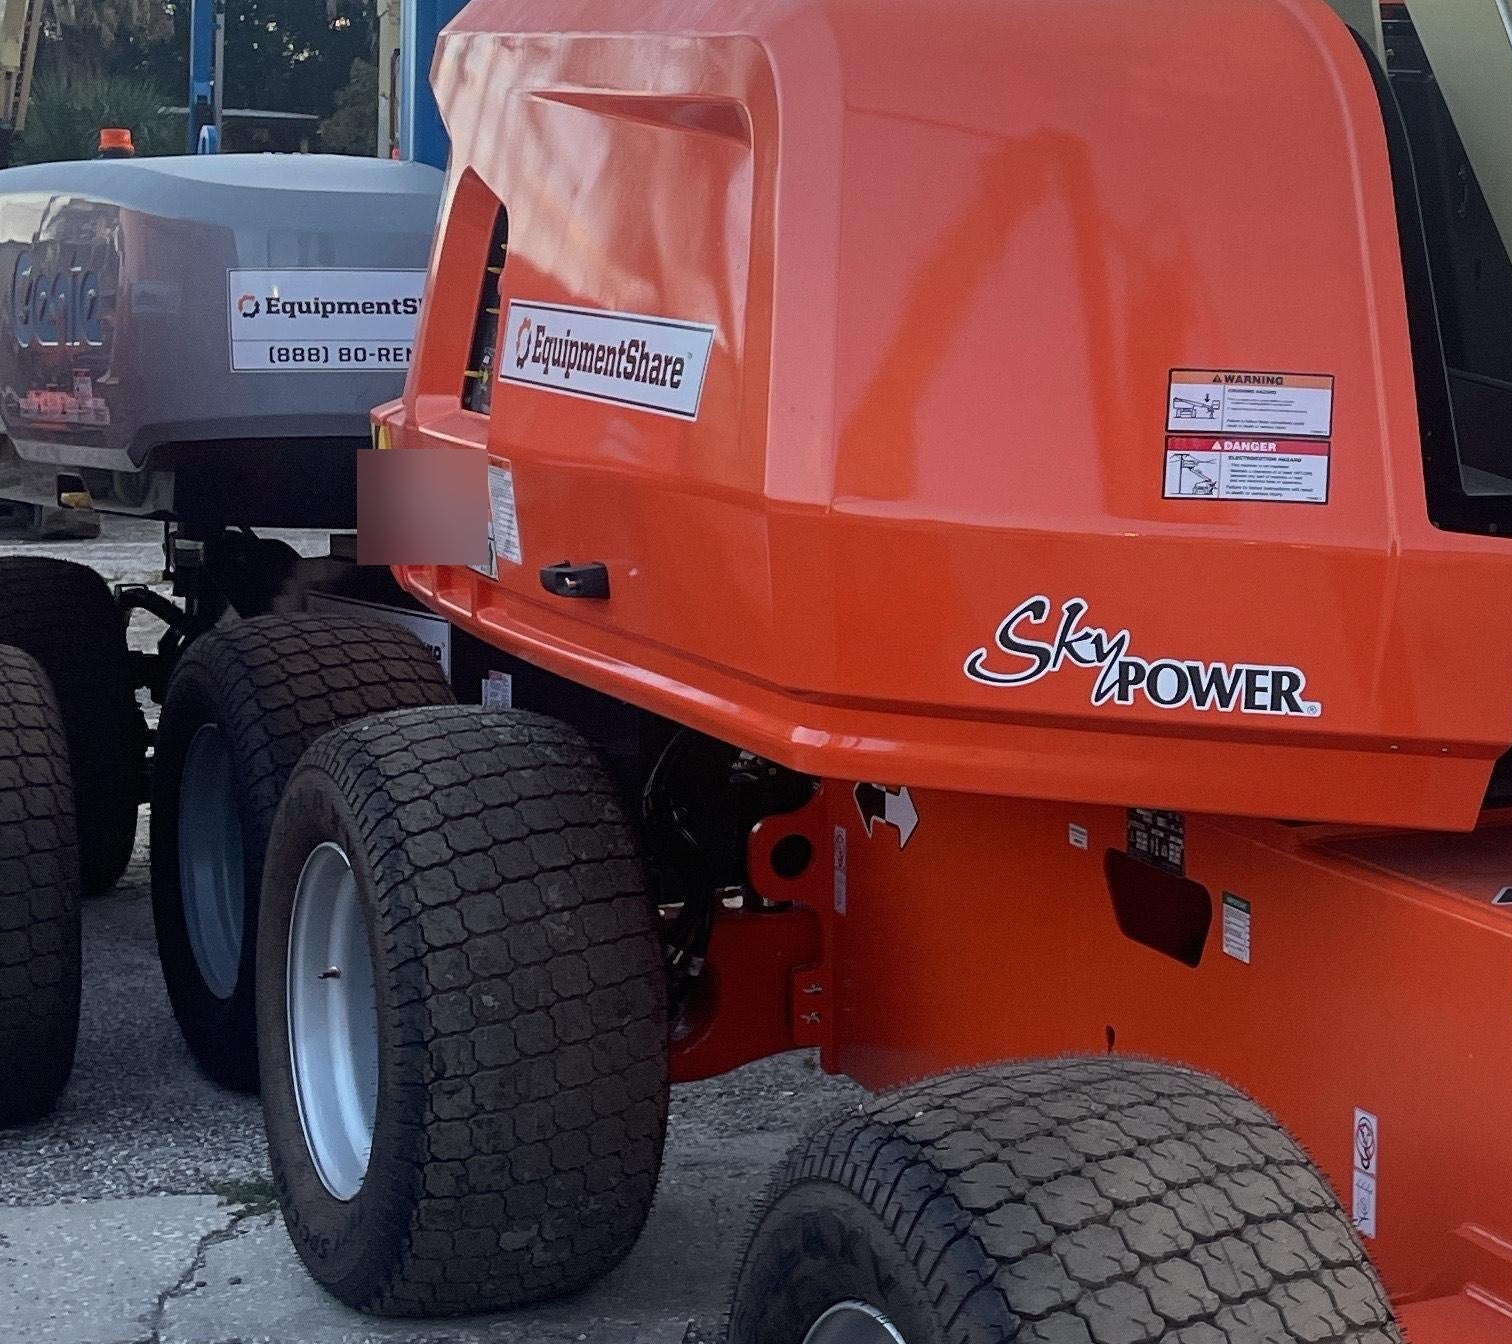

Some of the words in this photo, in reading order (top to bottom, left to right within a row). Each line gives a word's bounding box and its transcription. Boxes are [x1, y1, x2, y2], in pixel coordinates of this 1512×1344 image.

[265, 296, 422, 318] EquipmentS
[269, 346, 330, 364] (888)
[531, 324, 685, 390] EquipmentShare
[1224, 374, 1285, 386] WARNING
[1223, 440, 1277, 452] DANGER
